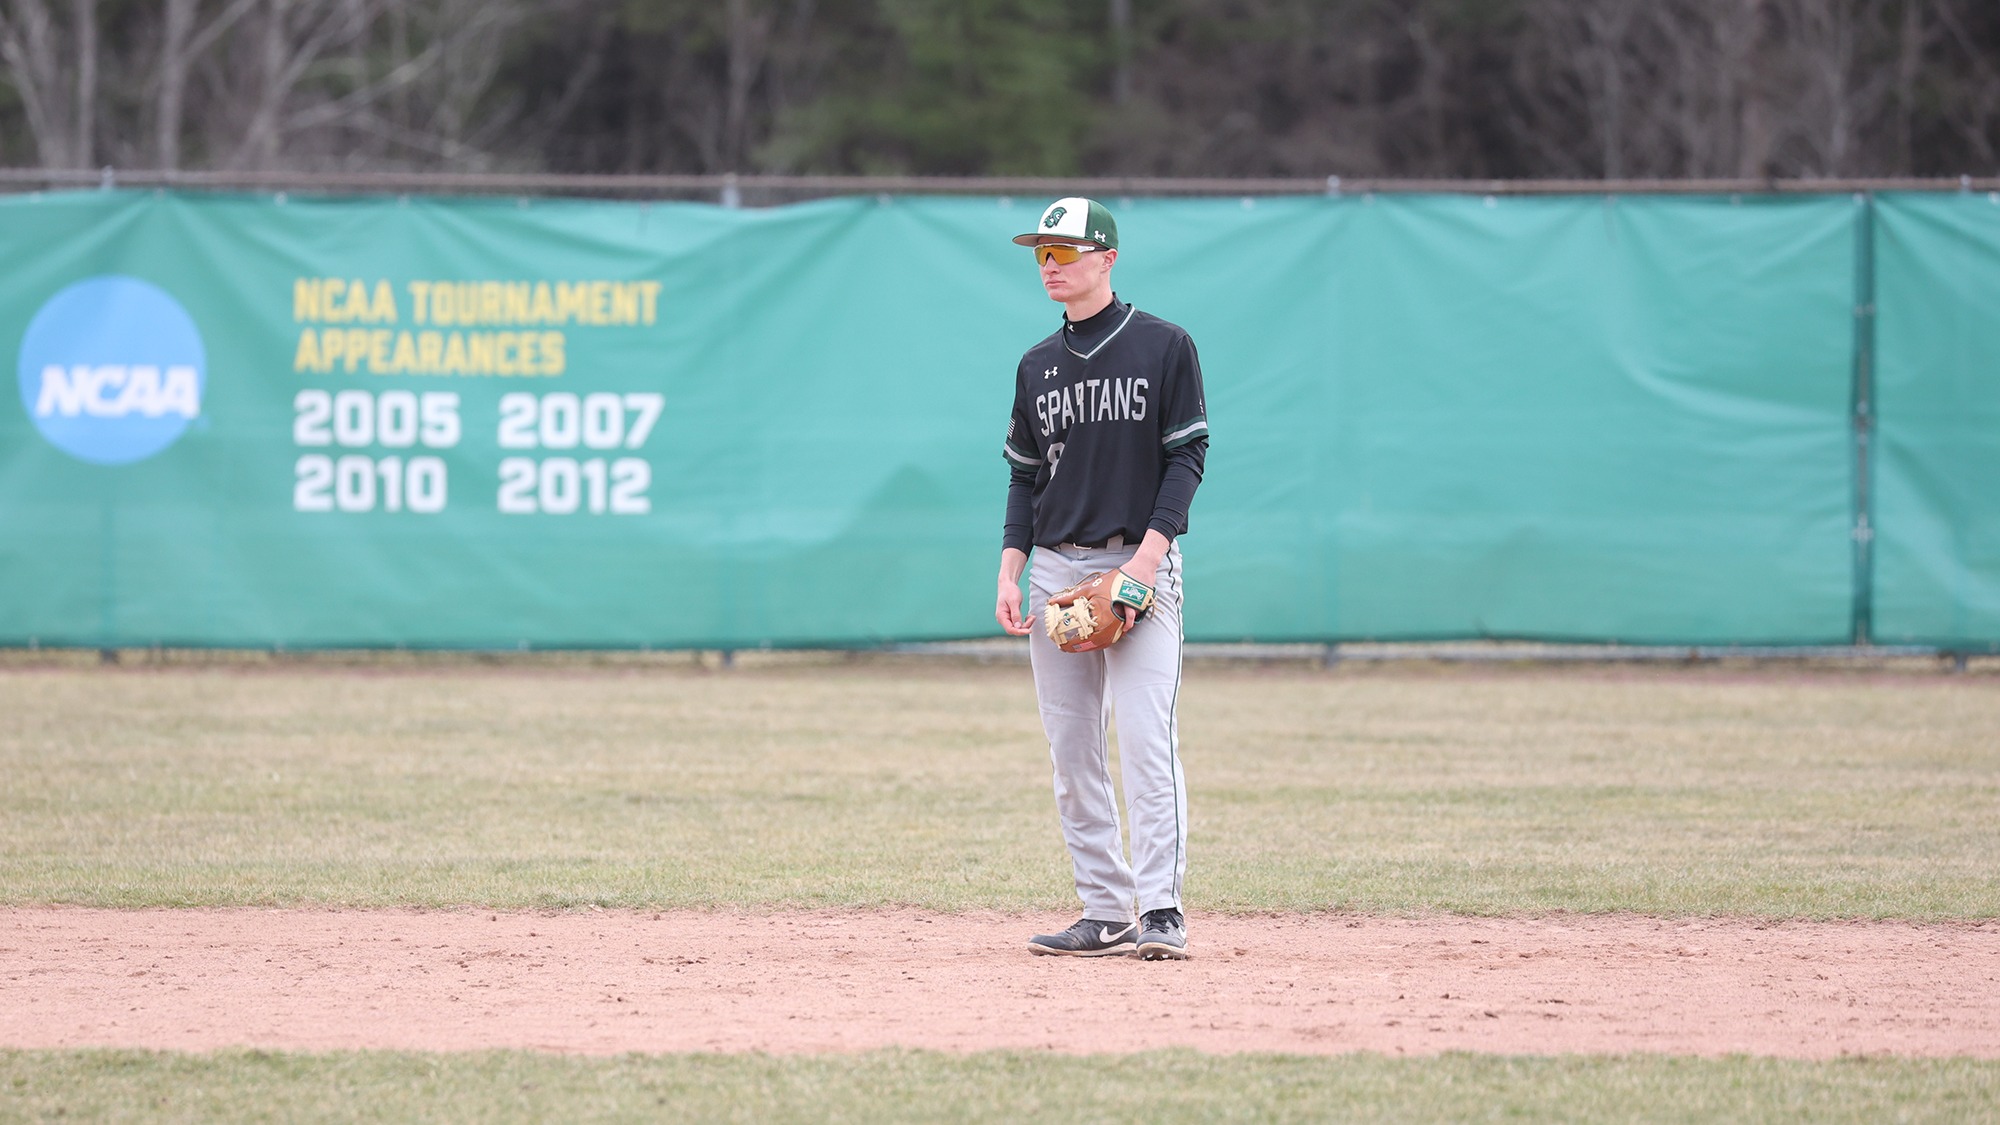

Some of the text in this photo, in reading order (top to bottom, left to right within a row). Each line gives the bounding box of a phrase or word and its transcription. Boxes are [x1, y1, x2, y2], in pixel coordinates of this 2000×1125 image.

[294, 278, 660, 325] NCAA TOURNAMENT
[294, 330, 565, 375] APPEARANCES
[36, 365, 200, 417] NCAA
[1036, 377, 1149, 437] SPARTANS
[293, 390, 664, 448] 2005 2007
[293, 456, 650, 513] 2010 2012
